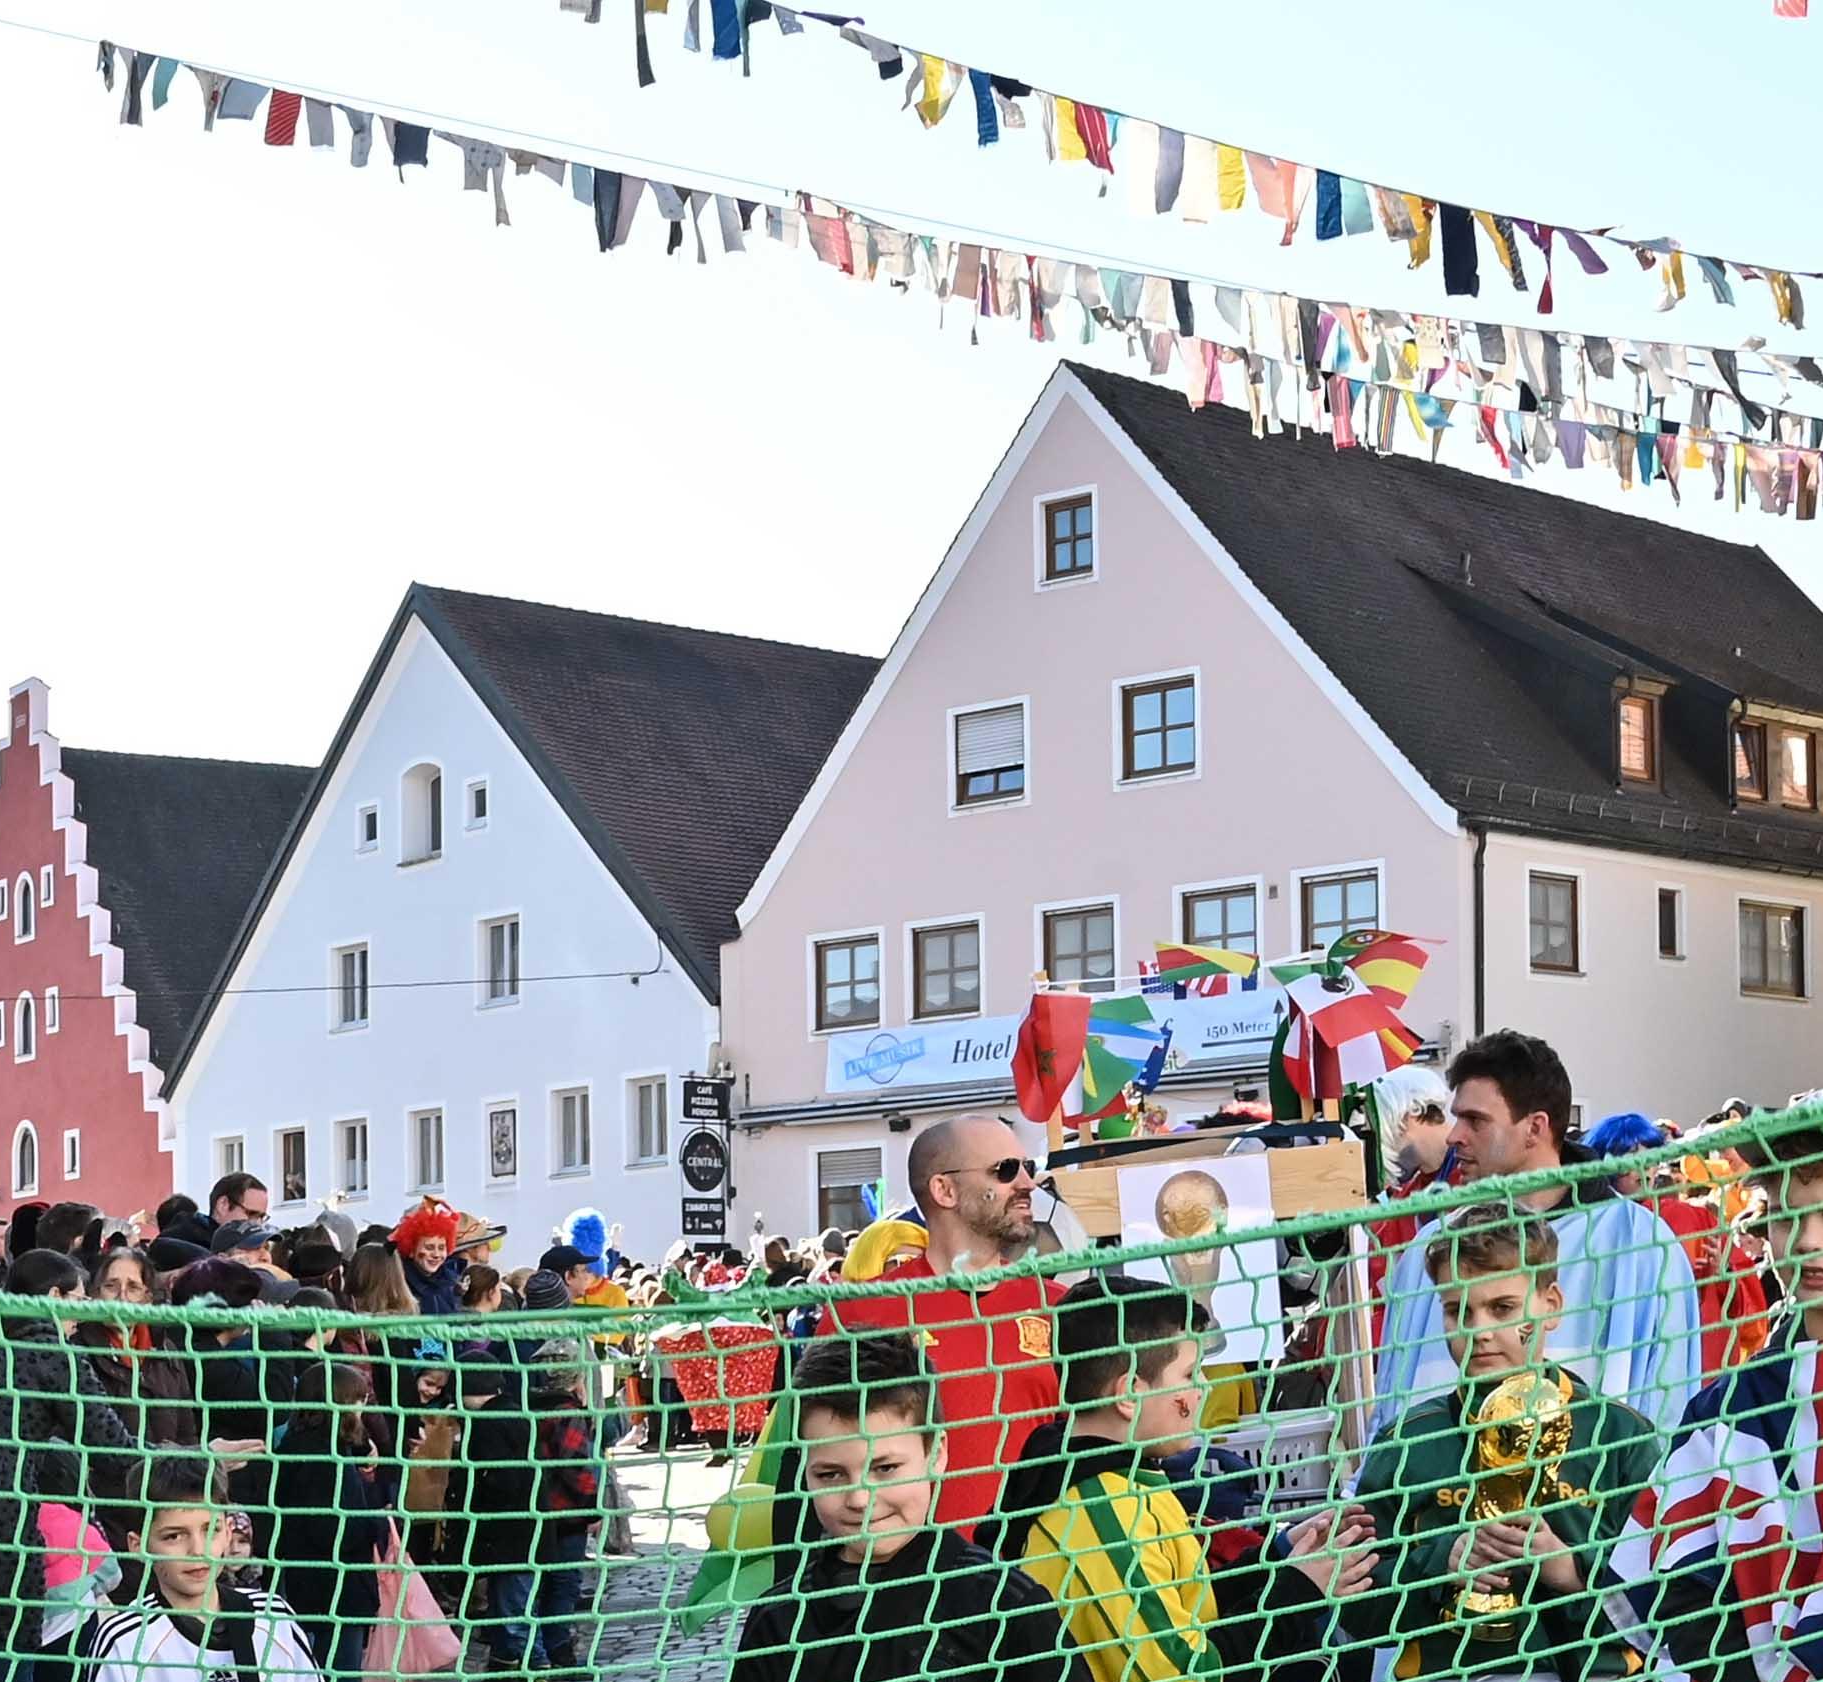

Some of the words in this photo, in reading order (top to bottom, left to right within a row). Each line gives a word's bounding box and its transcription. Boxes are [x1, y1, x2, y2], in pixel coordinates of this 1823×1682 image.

[1206, 1024, 1228, 1039] 150
[1232, 1022, 1271, 1035] Meter
[952, 1035, 1012, 1064] Hotel
[687, 1156, 723, 1168] CENTRAL
